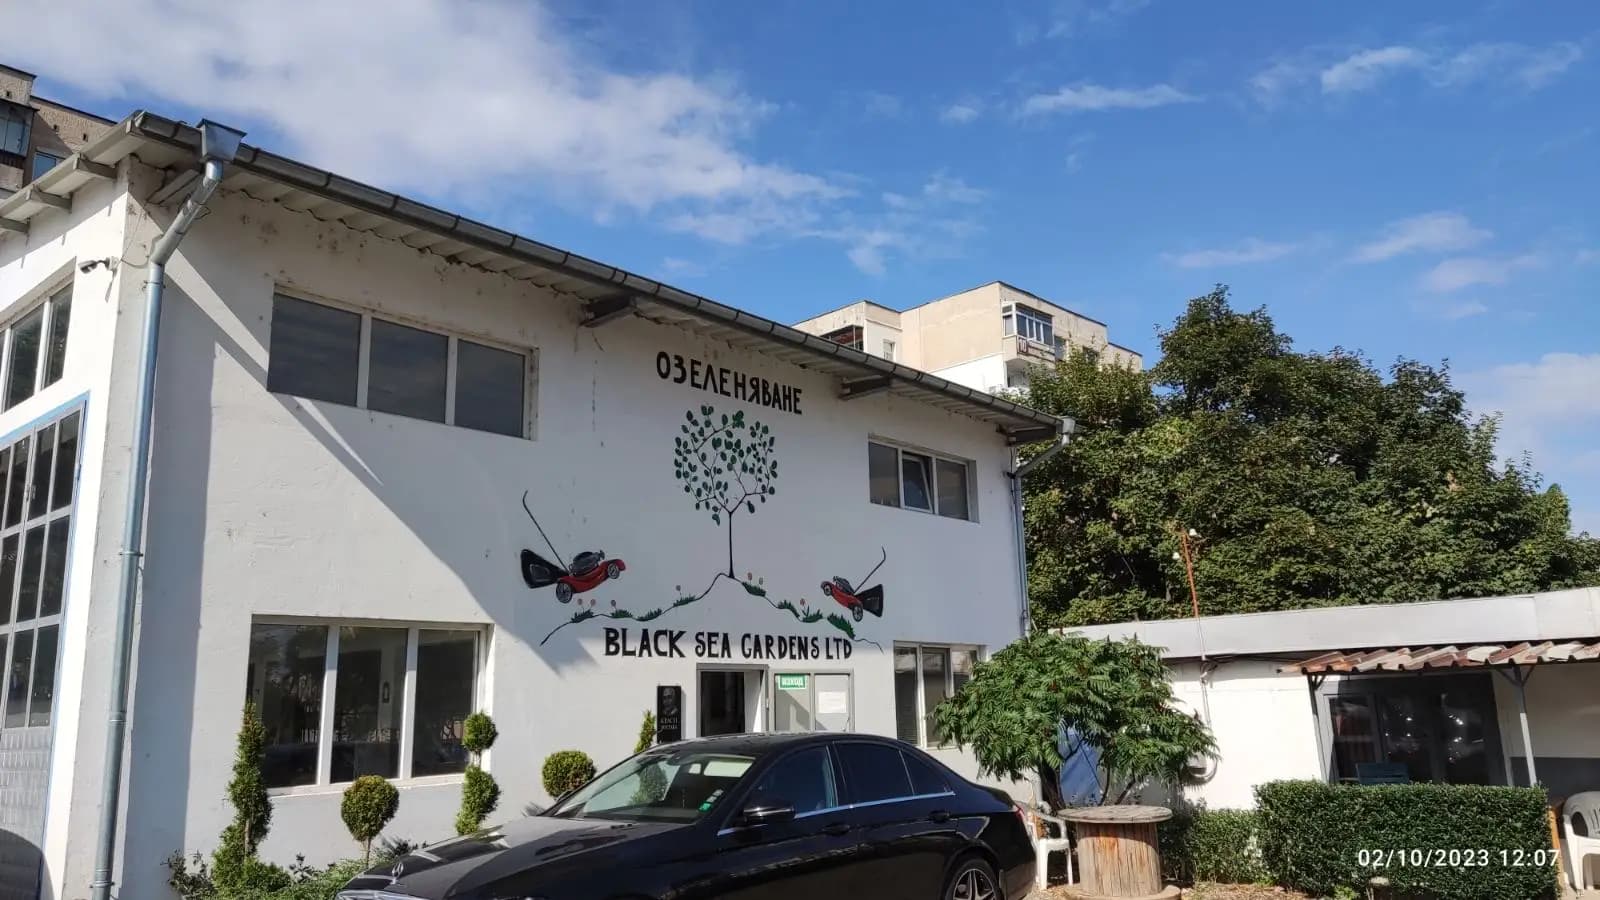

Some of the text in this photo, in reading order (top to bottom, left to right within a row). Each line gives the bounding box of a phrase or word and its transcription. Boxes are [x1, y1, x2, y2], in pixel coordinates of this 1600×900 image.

[656, 351, 802, 415] ОЗЕЛЕНЯВАНЕ
[603, 627, 853, 660] BLACK SEA GARDENS LTD
